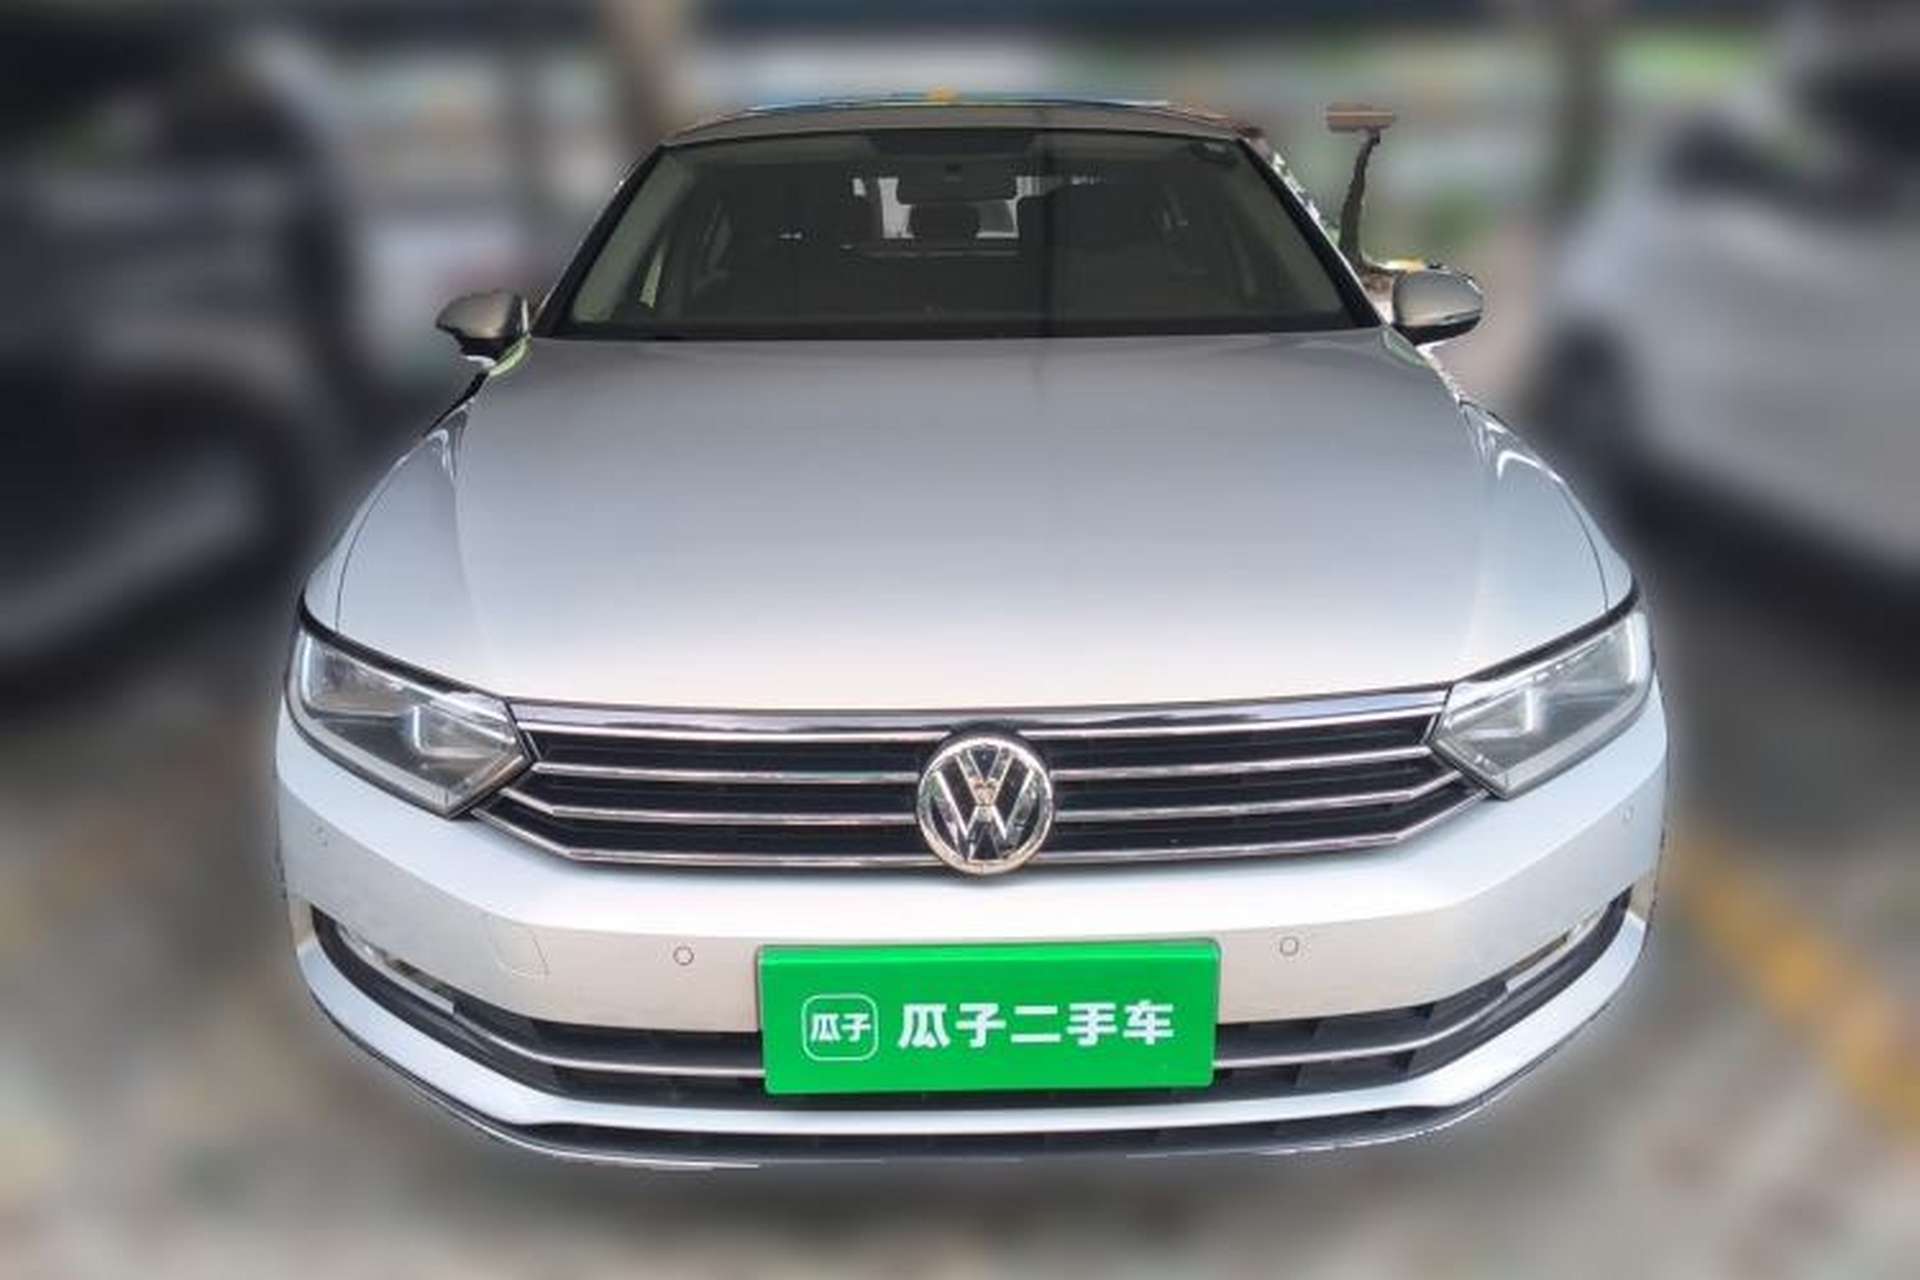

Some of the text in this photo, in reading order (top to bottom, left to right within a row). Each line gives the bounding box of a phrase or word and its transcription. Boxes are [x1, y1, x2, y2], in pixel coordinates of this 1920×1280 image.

[810, 1012, 871, 1042] 瓜子
[898, 1000, 1174, 1049] 瓜子二手车
